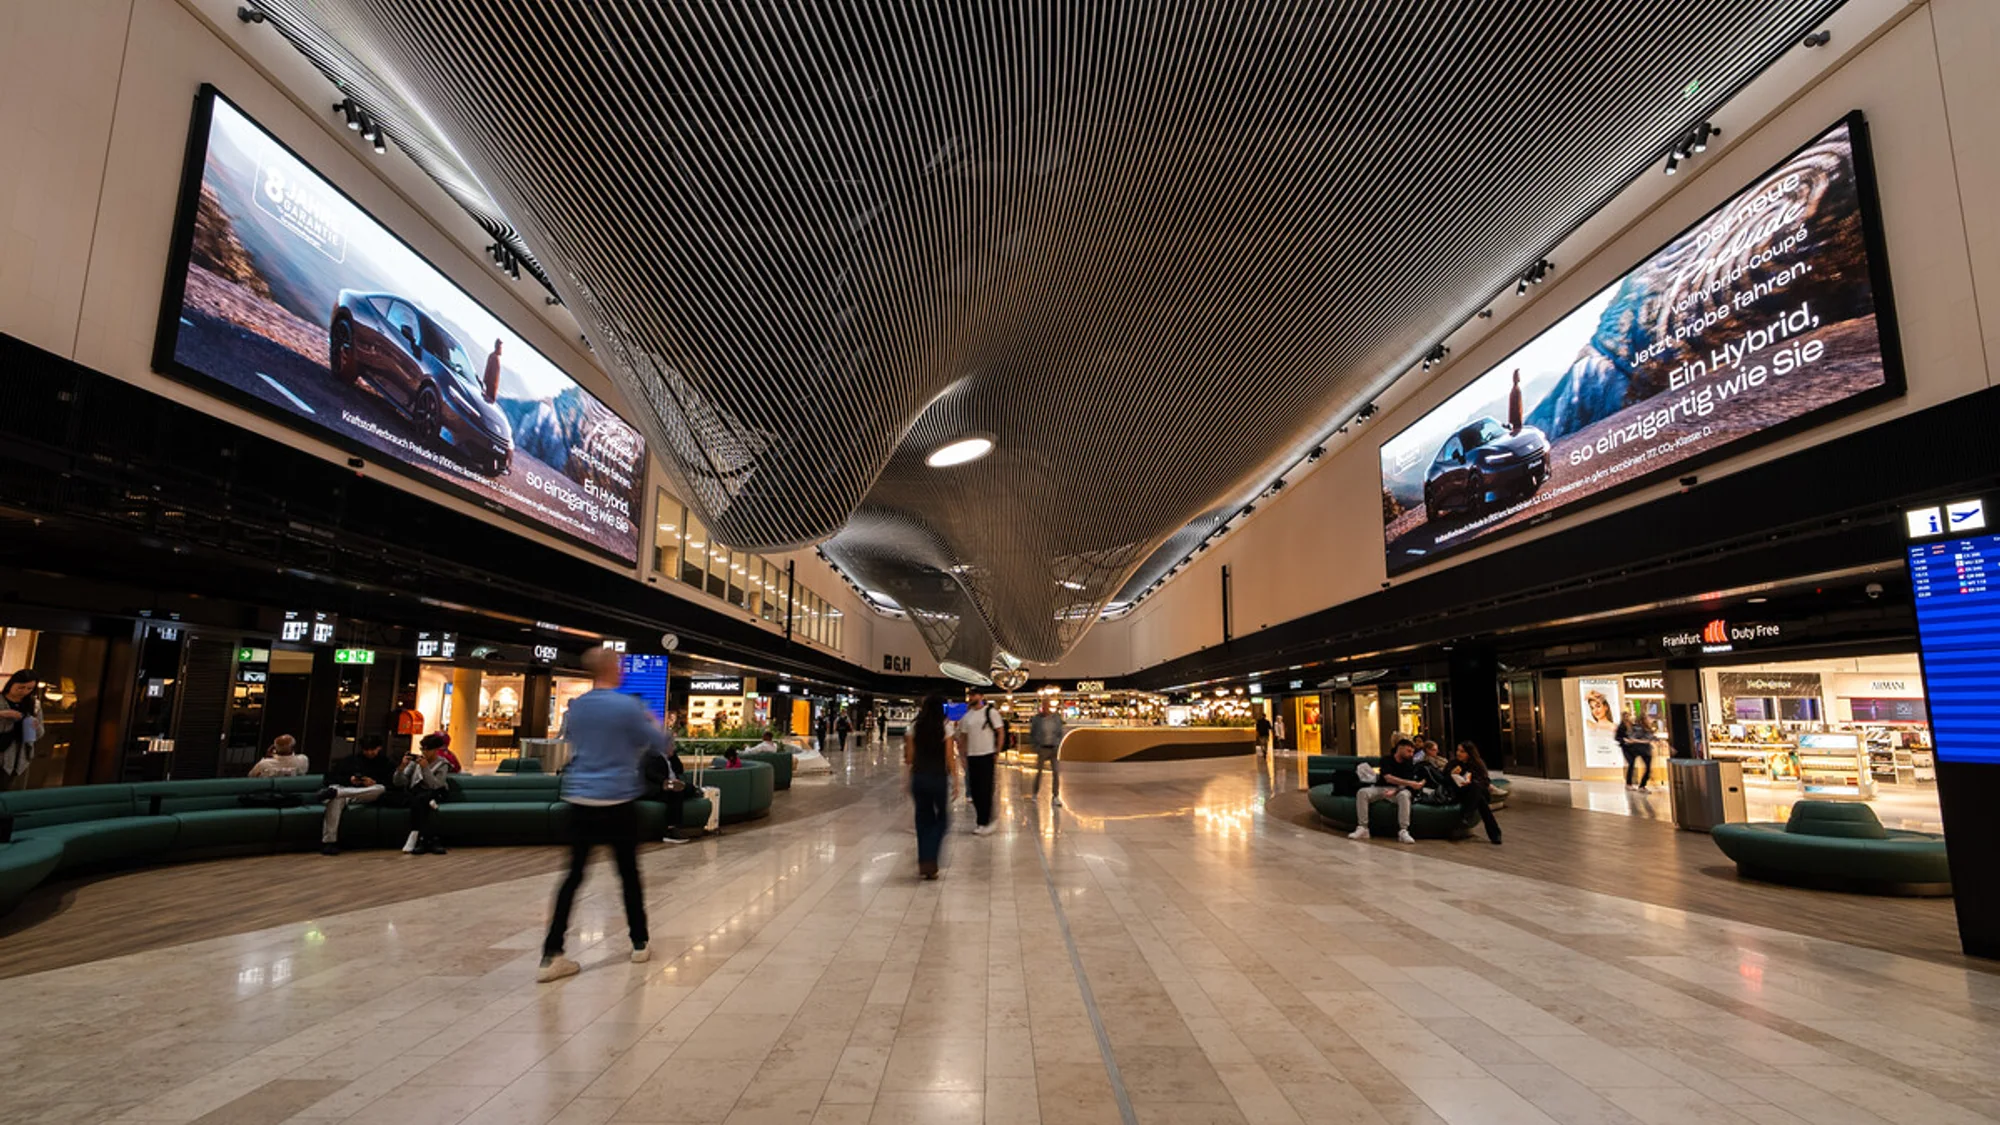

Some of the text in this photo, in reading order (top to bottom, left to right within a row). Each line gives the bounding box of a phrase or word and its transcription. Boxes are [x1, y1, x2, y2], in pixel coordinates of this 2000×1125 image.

[1696, 173, 1800, 251] Der neue
[1667, 200, 1804, 297] Prelude
[1630, 261, 1813, 368] Jetzt Probe fahren.
[1668, 301, 1820, 391] Ein Hybrid,
[1569, 338, 1824, 467] so einzigartig wie Sie
[525, 471, 629, 533] so einzigartig wie Sie
[584, 478, 599, 498] Ein
[599, 487, 630, 517] Hybrid,
[1662, 624, 1780, 647] Frankfurt Duty Free
[690, 681, 740, 691] MONTBLANC
[1625, 677, 1650, 689] TOM
